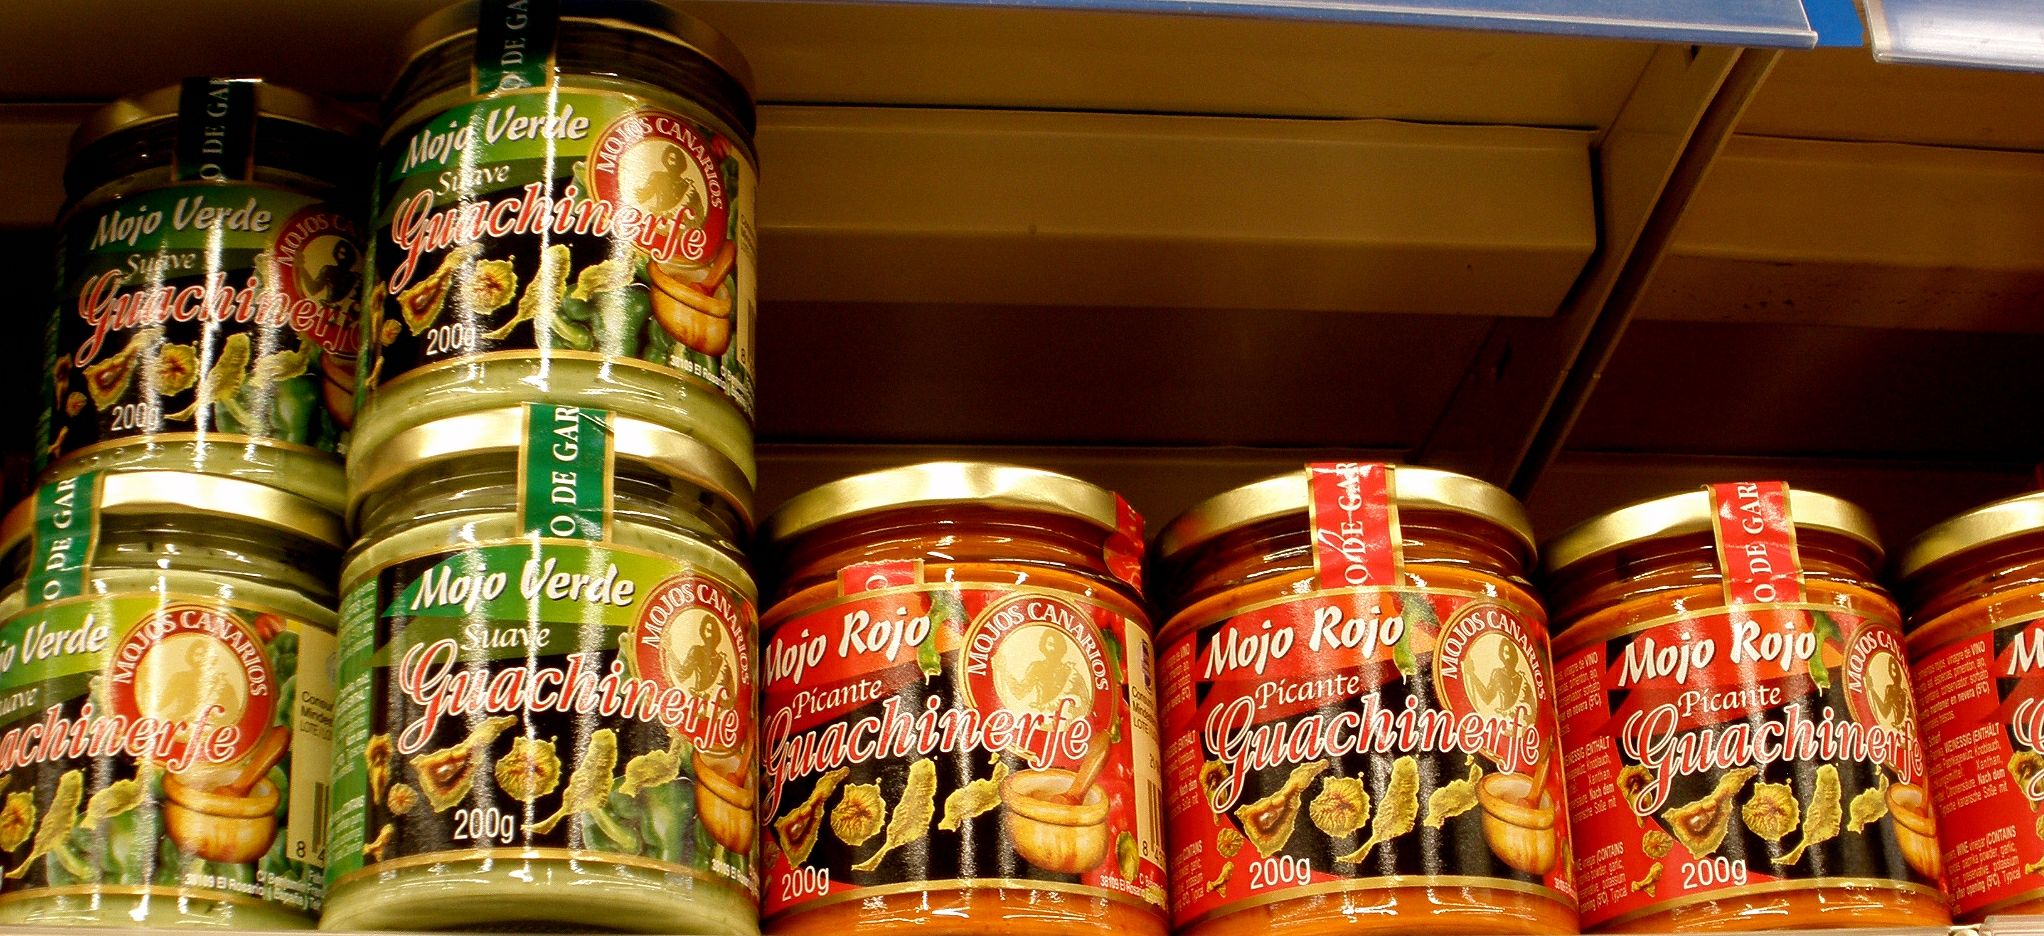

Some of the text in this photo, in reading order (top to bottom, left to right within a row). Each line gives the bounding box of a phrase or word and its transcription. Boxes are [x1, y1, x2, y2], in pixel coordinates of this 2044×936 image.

[501, 33, 525, 67] DE
[202, 124, 225, 154] DE
[402, 104, 590, 173] Mojo Verde
[595, 117, 723, 209] MOJOS CANARIOS
[436, 163, 510, 197] Suave
[89, 196, 272, 250] Mojo Verde
[277, 213, 328, 268] MOJOS
[388, 184, 707, 294] Guachinerfe
[125, 250, 196, 279] Suave
[426, 323, 476, 357] 200g
[110, 403, 160, 432] 200g
[552, 405, 579, 462] GAR
[53, 475, 78, 530] GAR
[551, 468, 577, 505] DE
[46, 537, 72, 571] DE
[1342, 518, 1366, 559] DE
[1748, 544, 1771, 577] DE
[412, 557, 635, 612] Mojo Verde
[21, 613, 110, 667] Verde
[113, 611, 178, 684] MOJOS
[180, 609, 268, 697] CANARIOS
[461, 622, 550, 651] Suave
[641, 577, 751, 685] MOJOS CANARIOS
[761, 606, 931, 690] Mojo Rojo
[966, 601, 1110, 691] MOJOS CANARIOS
[1204, 620, 1294, 679] Mojo
[1309, 605, 1404, 659] Rojo
[1440, 609, 1546, 701] MOJOS CANARIOS
[1618, 620, 1816, 687] Mojo Rojo
[1849, 633, 1878, 694] MOJOS
[0, 687, 39, 720] uave
[302, 691, 334, 711] Consu
[397, 639, 739, 755] Guachinerfe
[792, 677, 883, 721] Picante
[1255, 672, 1360, 711] Picante
[1677, 685, 1781, 718] Picante
[0, 702, 241, 775] achinerfe
[762, 694, 1091, 826] Guachinerfe
[1205, 695, 1540, 813] Guachinerfe
[1623, 704, 1924, 817] Guachinerfe
[296, 841, 305, 858] 8
[453, 806, 514, 844] 200g
[1143, 841, 1149, 856] 8
[781, 864, 830, 902] 200g
[1249, 856, 1312, 891] 200g
[1681, 858, 1748, 889] 200g
